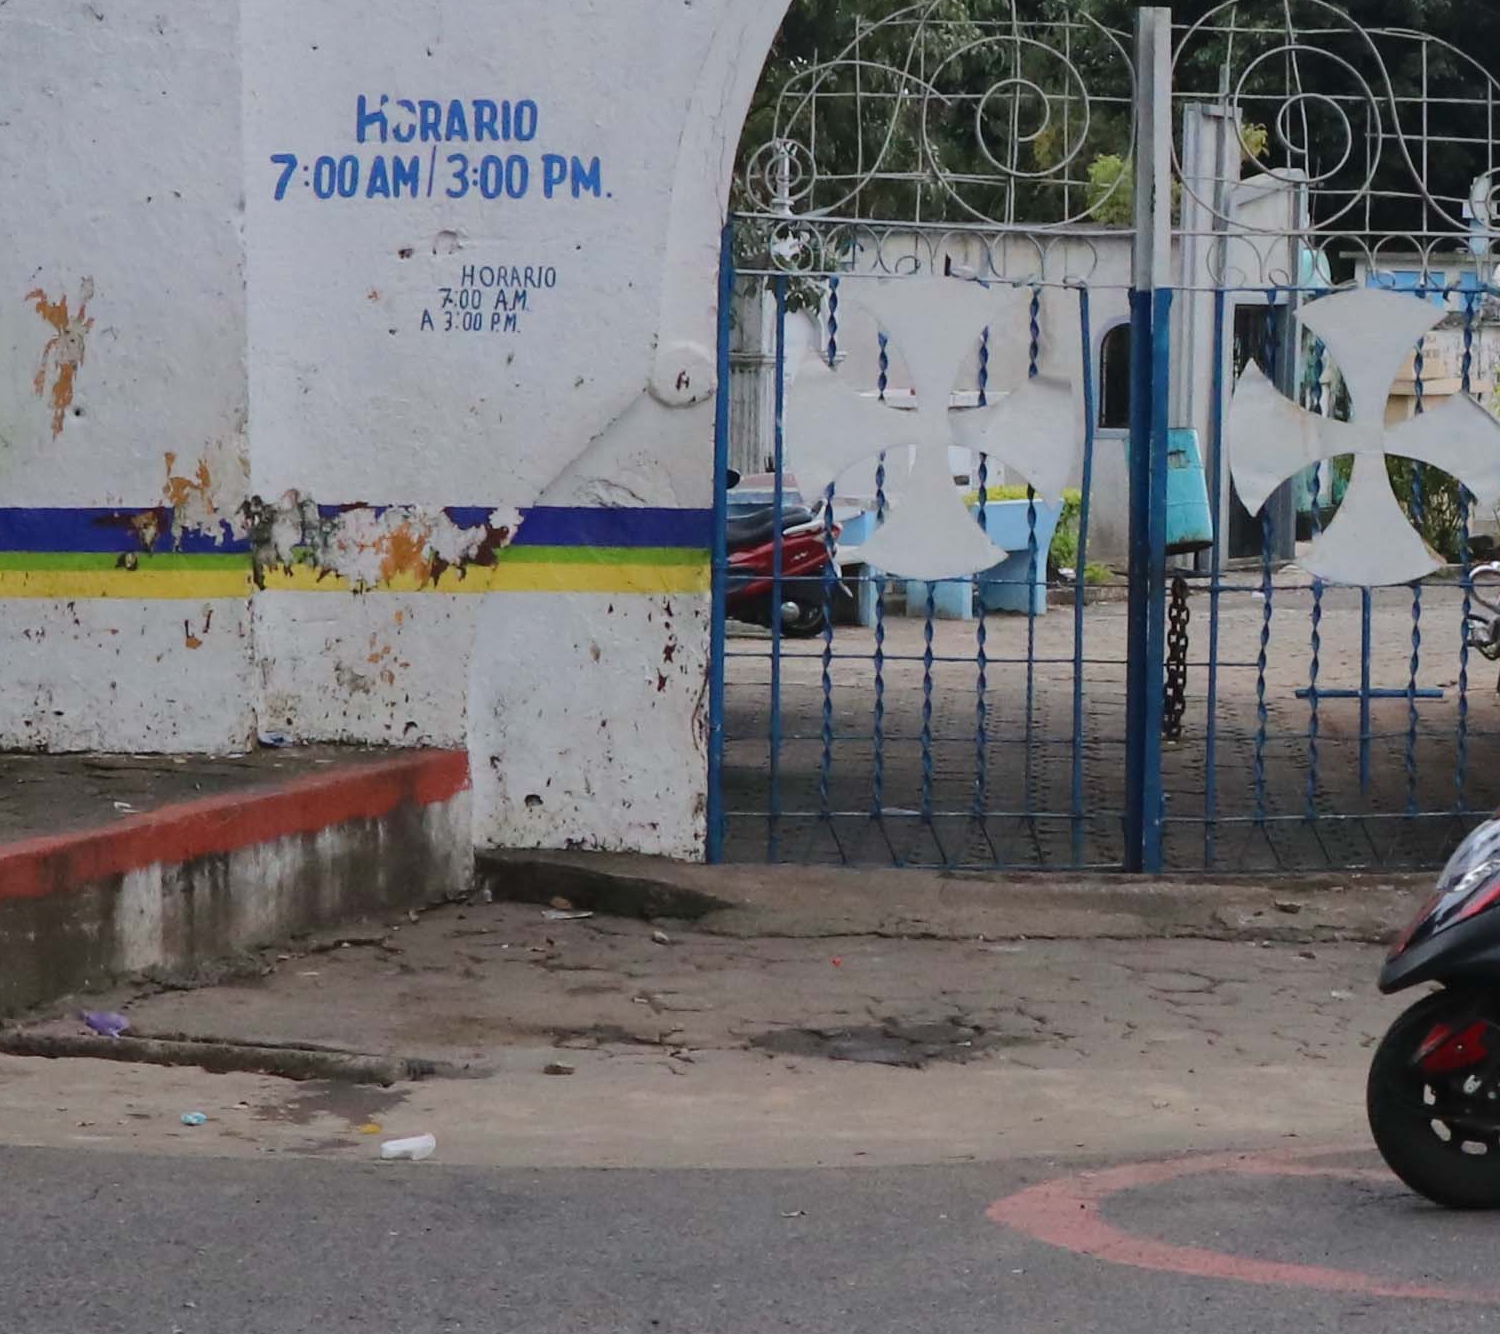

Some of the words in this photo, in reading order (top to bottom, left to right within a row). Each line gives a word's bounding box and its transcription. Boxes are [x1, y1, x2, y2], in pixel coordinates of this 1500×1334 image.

[356, 94, 538, 143] HORARIO
[270, 154, 359, 200] 7:00
[461, 265, 557, 289] HORARIO
[438, 288, 482, 311] 7:00
[420, 309, 434, 331] A
